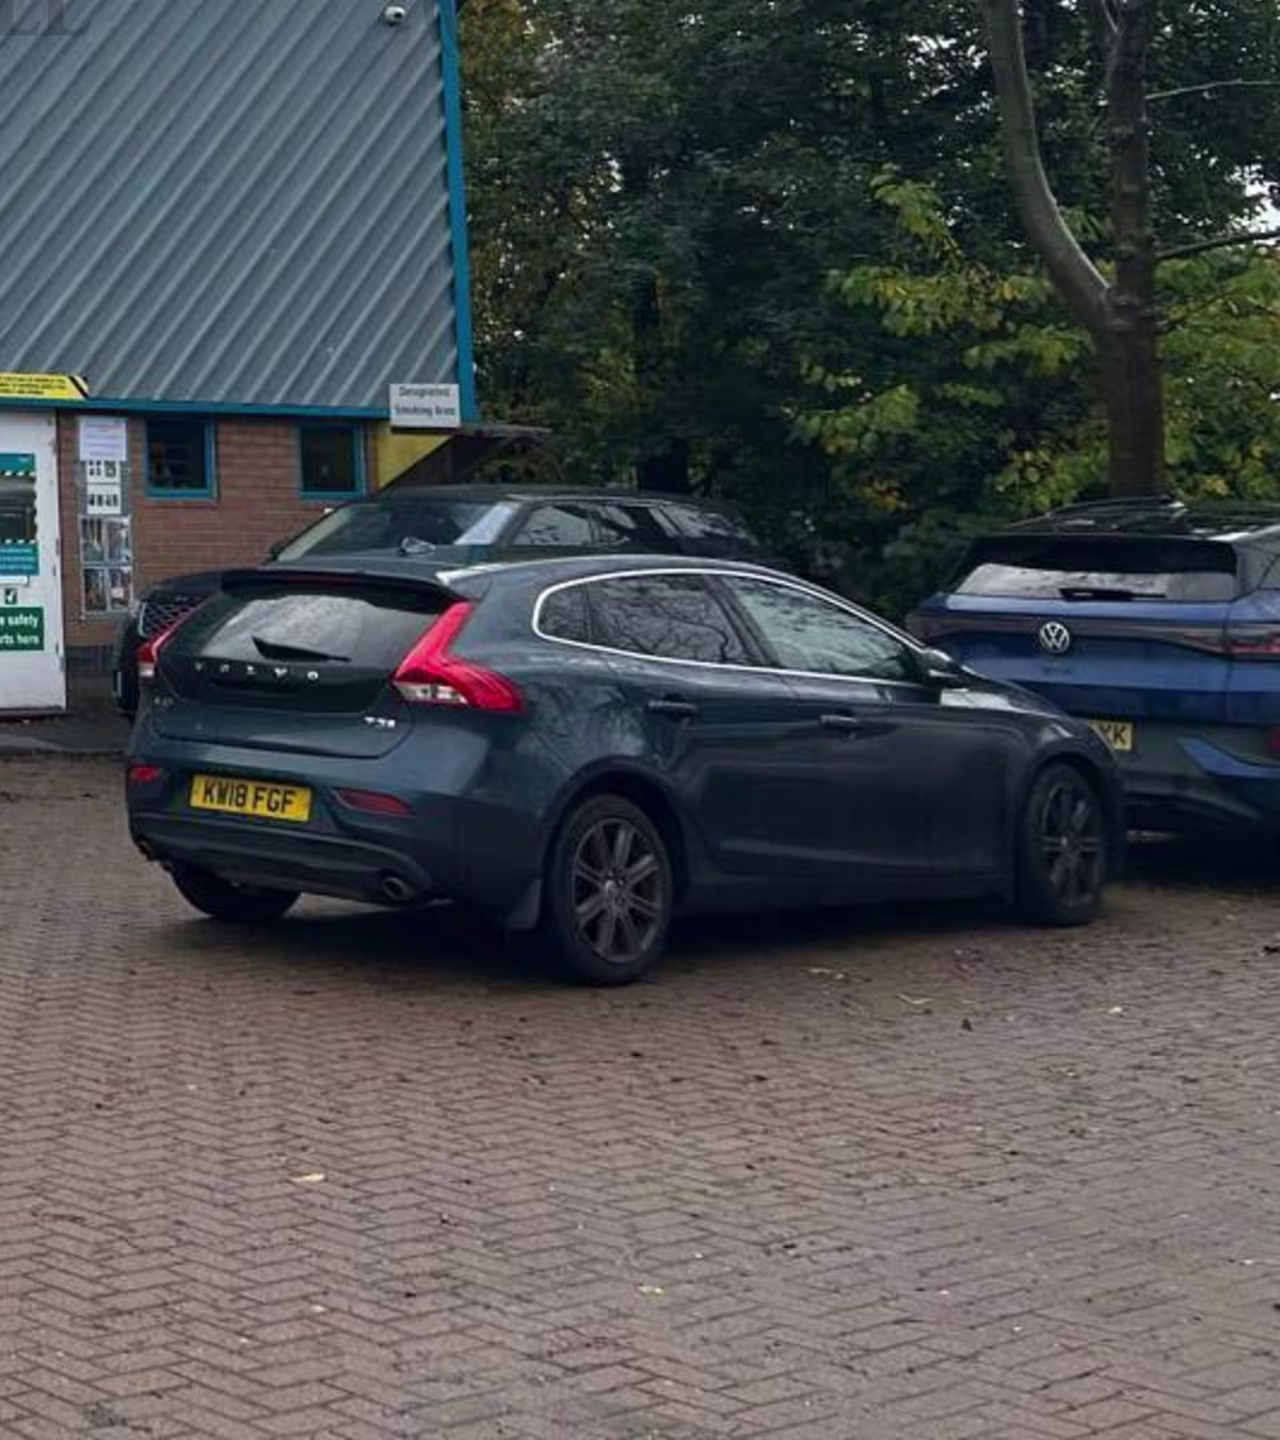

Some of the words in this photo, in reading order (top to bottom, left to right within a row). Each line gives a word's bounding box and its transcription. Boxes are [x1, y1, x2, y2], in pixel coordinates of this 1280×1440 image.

[7, 613, 38, 629] safety
[202, 779, 248, 808] KW18
[252, 786, 297, 815] FGF
